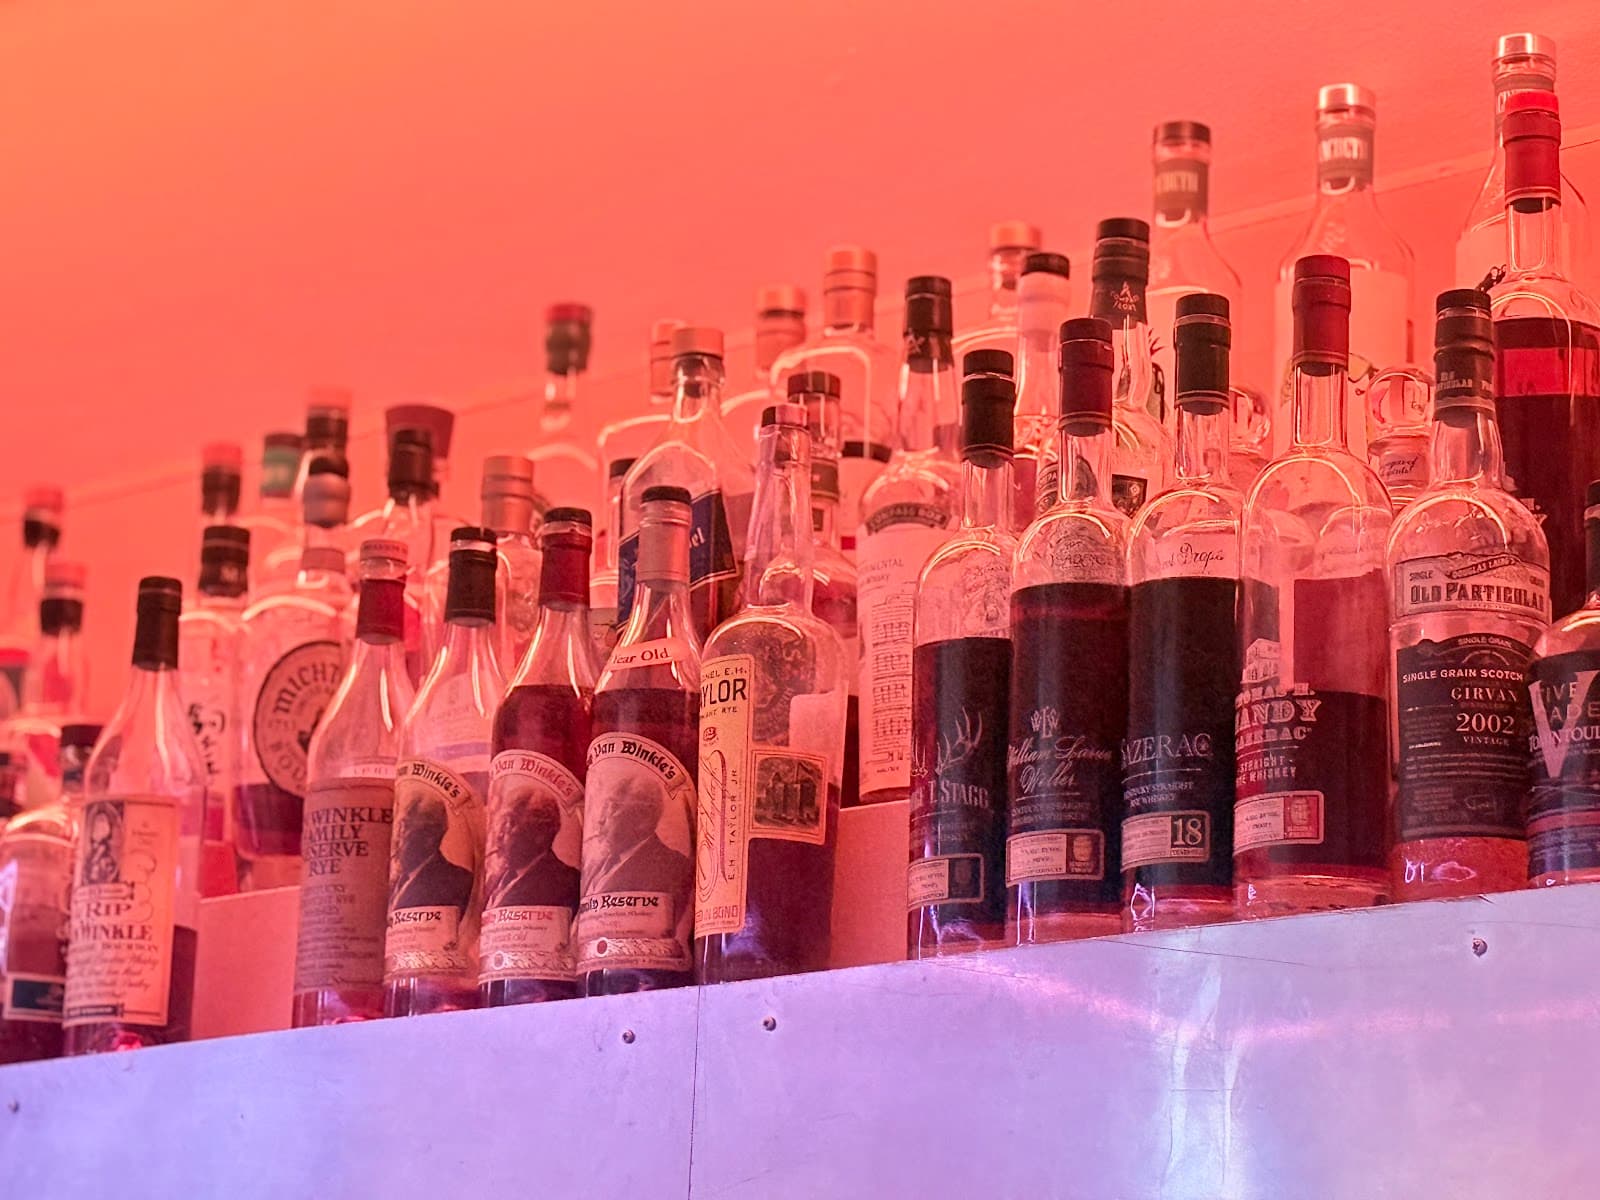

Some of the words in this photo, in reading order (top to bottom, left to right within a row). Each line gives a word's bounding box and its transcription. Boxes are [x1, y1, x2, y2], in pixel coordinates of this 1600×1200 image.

[1409, 570, 1434, 581] SINGLE
[1411, 585, 1442, 604] OLD
[1458, 636, 1487, 646] SINGLE
[641, 647, 671, 661] Old
[1403, 669, 1438, 684] SINGLE
[1440, 668, 1477, 679] GRAIN
[1480, 668, 1523, 681] SCOTCH
[701, 678, 747, 709] YLOR
[1451, 687, 1518, 702] GIRVAN
[1456, 712, 1514, 735] 2002
[1463, 735, 1511, 746] VINTAGE
[620, 740, 677, 781] Winkle's
[411, 762, 462, 799] Winkle's
[520, 758, 573, 798] Winkle's
[1021, 761, 1077, 794] Weller
[940, 779, 989, 809] STAGG
[312, 807, 393, 824] WINKLE
[729, 795, 738, 846] TAYLOR
[1173, 818, 1202, 846] 18
[309, 859, 342, 877] RYE
[86, 903, 131, 917] RIP
[601, 895, 659, 909] Reserve
[395, 911, 442, 926] Reserve
[498, 910, 554, 923] Reserve
[713, 904, 738, 920] BOND
